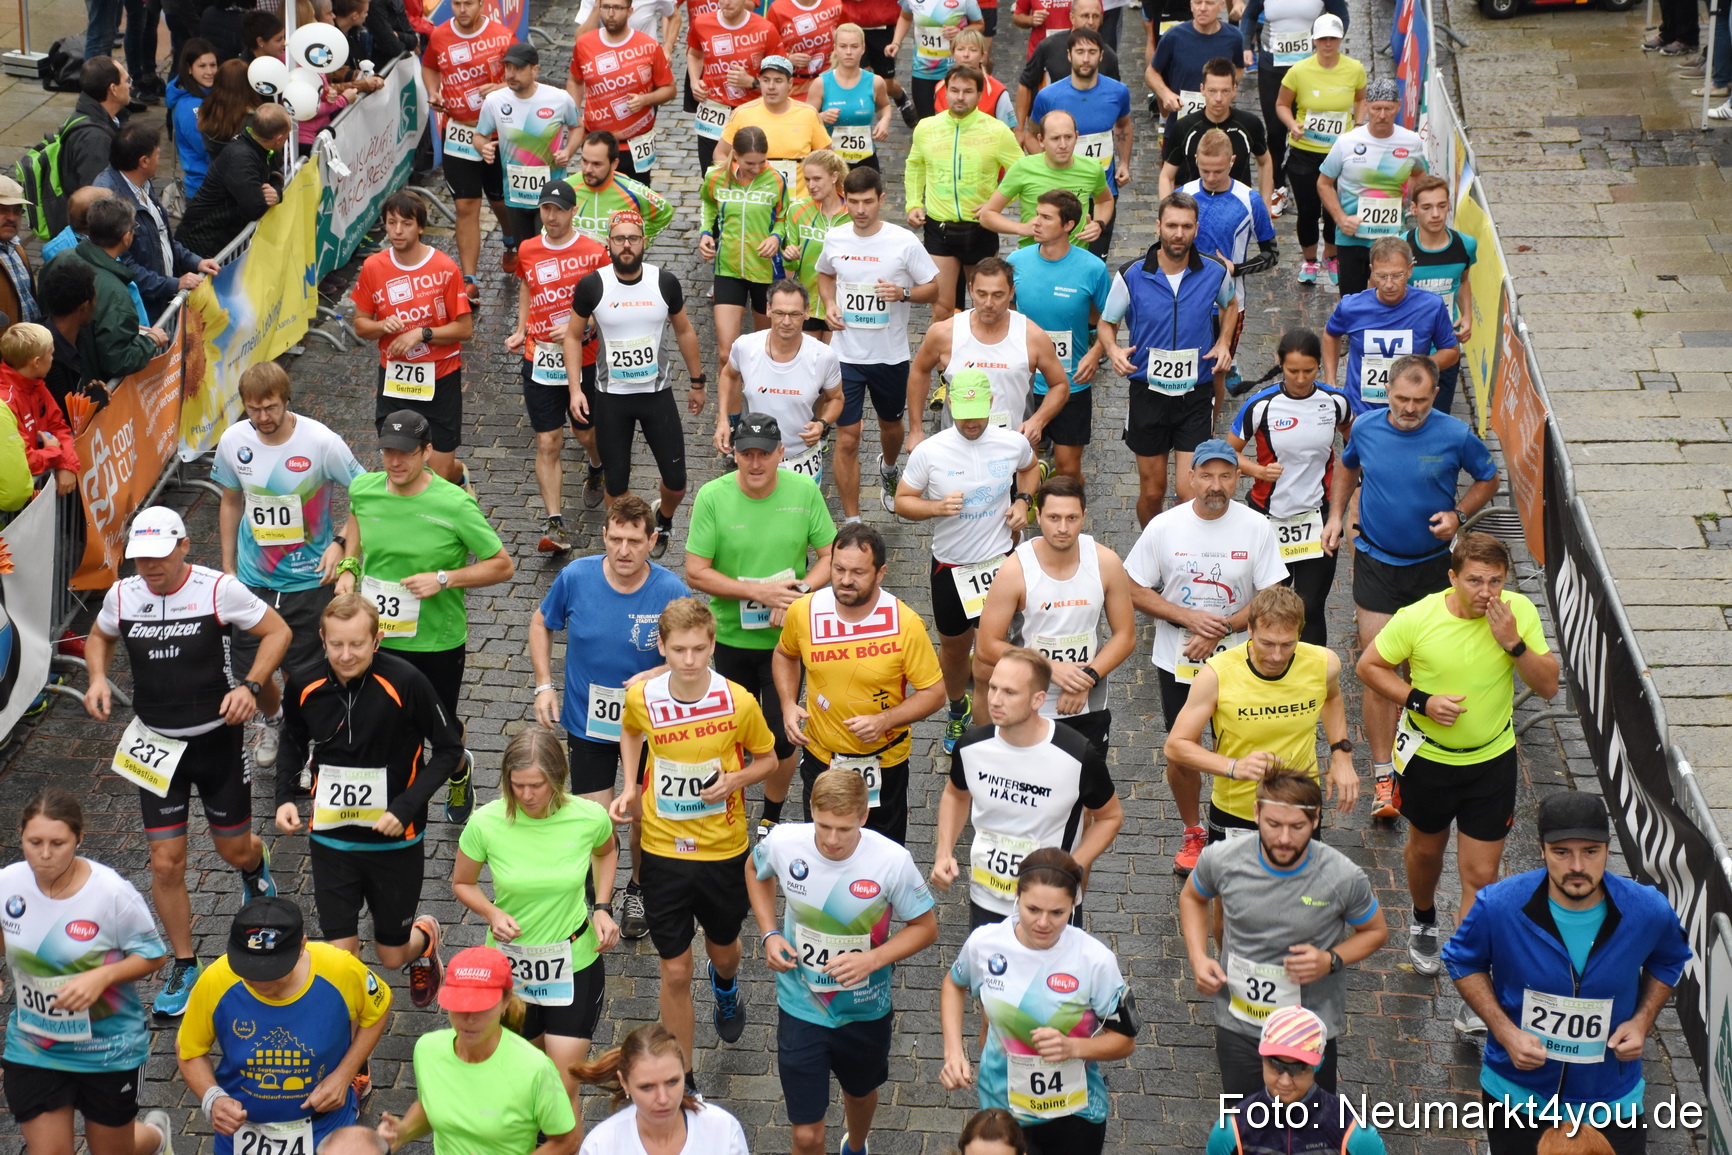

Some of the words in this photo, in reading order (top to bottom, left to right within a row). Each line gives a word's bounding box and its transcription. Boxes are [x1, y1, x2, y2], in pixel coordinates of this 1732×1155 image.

[922, 34, 942, 48] 341
[1278, 39, 1308, 53] 3055
[697, 106, 726, 126] 2620
[1308, 118, 1342, 134] 2670
[840, 136, 866, 149] 256
[1085, 143, 1102, 158] 47
[512, 175, 546, 190] 2704
[717, 189, 777, 206] BOCK
[1362, 208, 1398, 224] 2028
[846, 294, 886, 311] 2076
[854, 314, 876, 324] Sergej
[612, 346, 654, 367] 2539
[395, 364, 424, 384] 276
[622, 370, 648, 378] Thomas
[1153, 360, 1192, 378] 2281
[396, 384, 422, 394] Gerhard
[1157, 381, 1188, 390] Bernhard
[253, 506, 290, 526] 610
[959, 508, 997, 520] Finisher
[1278, 522, 1312, 544] 357
[290, 552, 305, 561] 17.
[1285, 544, 1308, 556] Sabine
[1054, 600, 1091, 608] KLEBL
[128, 622, 201, 640] Energizer
[810, 648, 850, 662] MAX
[856, 642, 902, 658] BÖGL
[595, 698, 625, 722] 30
[1238, 699, 1316, 716] KLINGELE
[654, 730, 690, 745] MAX
[694, 721, 738, 738] BÖGL
[129, 738, 170, 768] 237
[124, 759, 158, 785] Sebastian
[661, 774, 702, 797] 270
[988, 774, 1052, 798] INTERSPORT
[329, 782, 373, 807] 262
[990, 788, 1038, 807] HÄCKL
[340, 810, 360, 820] Olaf
[674, 802, 706, 812] Yannik
[786, 880, 808, 892] PARTL
[990, 876, 1012, 891] David
[507, 956, 565, 981] 2307
[524, 986, 548, 996] Karin
[1246, 978, 1276, 1004] 32
[22, 984, 76, 1016] 302
[1246, 1004, 1272, 1020] Rupe
[1531, 1006, 1602, 1038] 2706
[1546, 1040, 1579, 1054] Bernd
[1030, 1071, 1064, 1096] 64
[1030, 1100, 1066, 1111] Sabine
[242, 1131, 306, 1155] 2674
